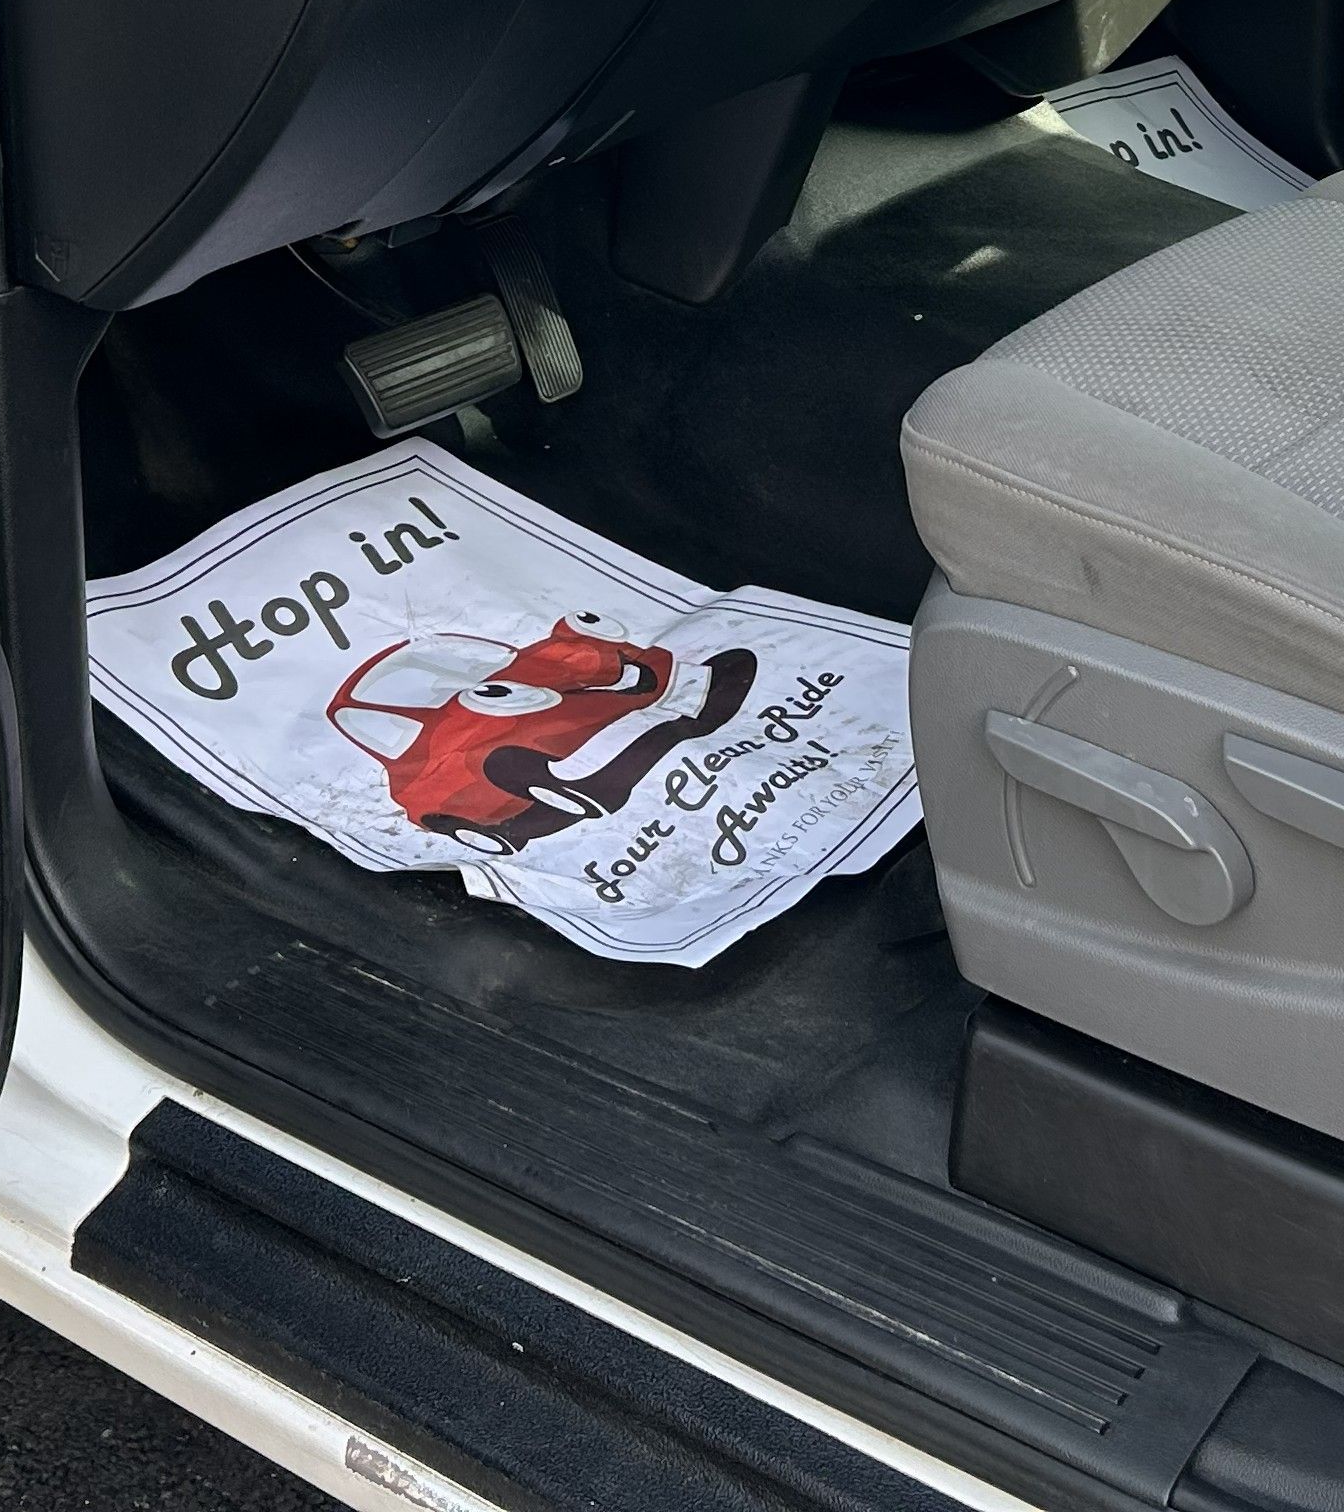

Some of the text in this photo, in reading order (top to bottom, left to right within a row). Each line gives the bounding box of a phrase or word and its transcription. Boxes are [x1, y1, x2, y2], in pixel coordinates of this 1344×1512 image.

[1137, 107, 1204, 160] in!
[171, 496, 460, 700] Hop in!
[584, 671, 845, 903] Your Clean Ride
[712, 740, 839, 865] Awaits!
[792, 805, 831, 833] FOR
